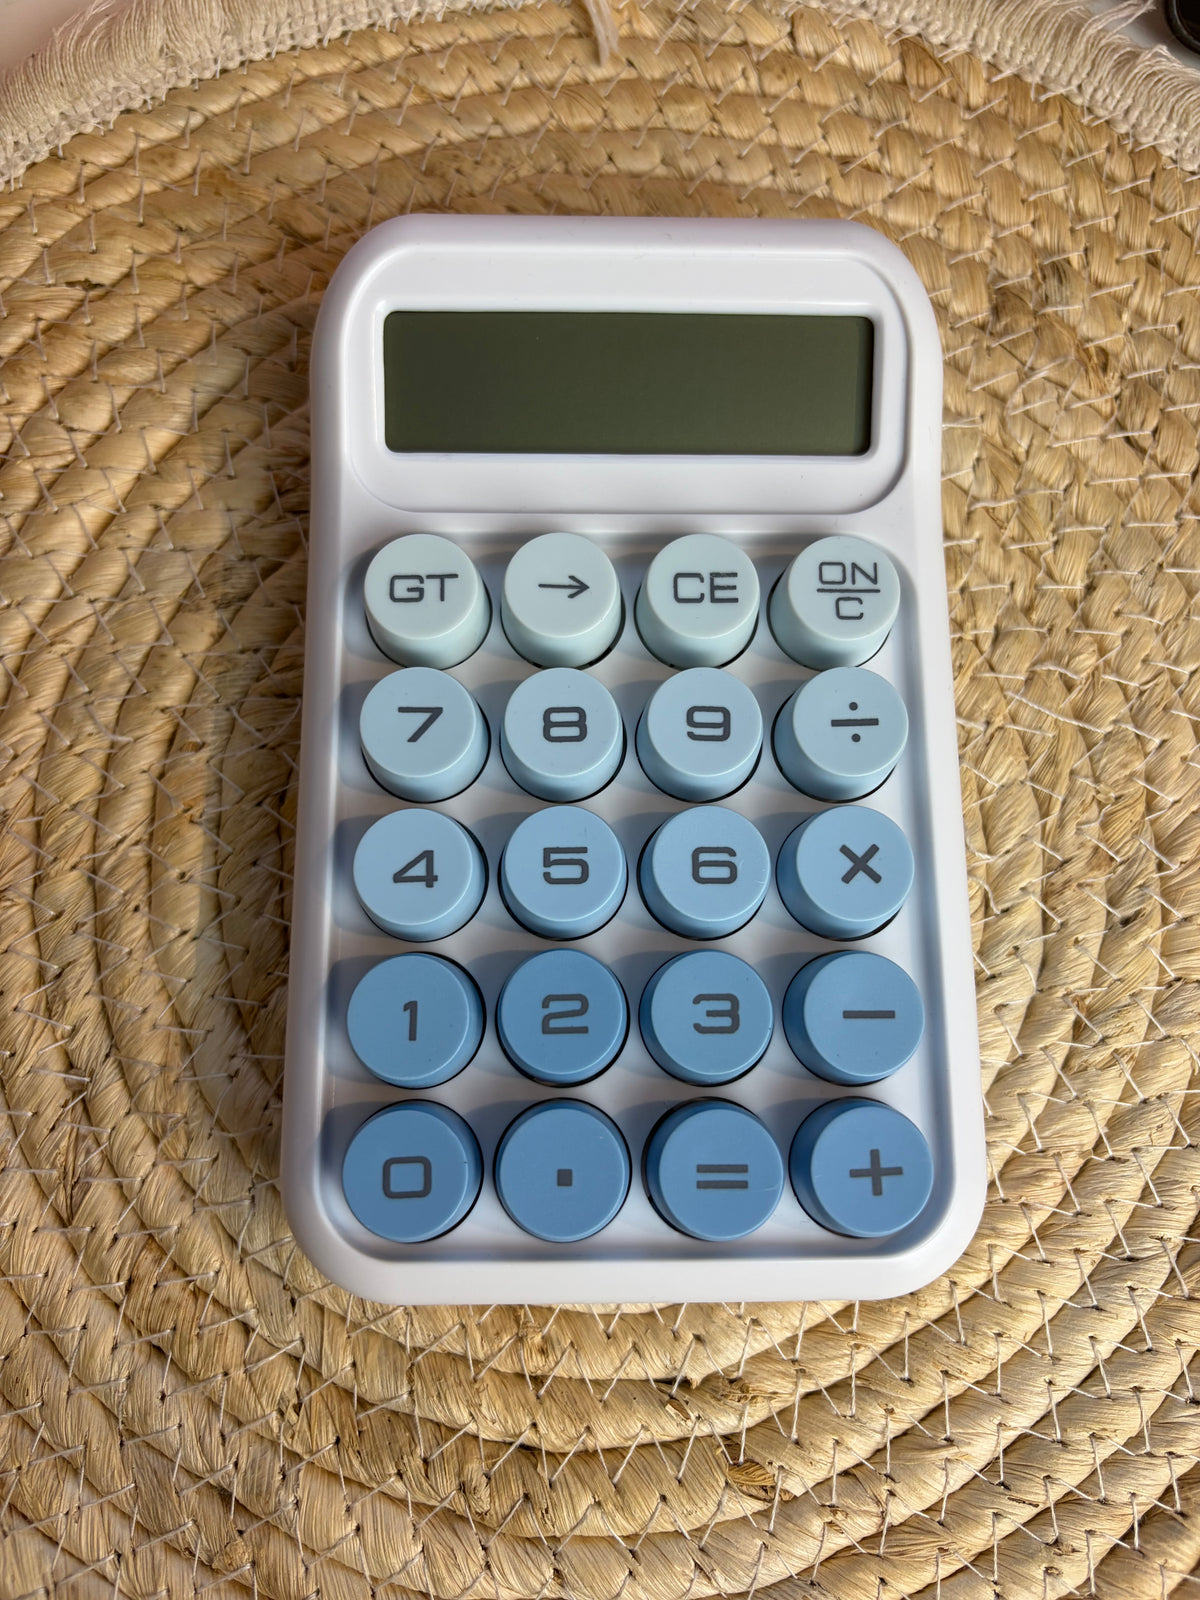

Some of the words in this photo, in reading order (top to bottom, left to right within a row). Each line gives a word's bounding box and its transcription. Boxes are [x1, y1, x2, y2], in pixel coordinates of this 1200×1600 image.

[388, 573, 459, 604] GT
[672, 571, 740, 604] CE
[818, 561, 879, 586] ON
[834, 595, 865, 621] C
[397, 706, 444, 743] 7
[542, 706, 588, 744] 8
[685, 705, 732, 743] 9
[392, 849, 439, 889] 4
[542, 846, 590, 885] 5
[691, 846, 738, 885] 6
[402, 1000, 418, 1042] 1
[541, 993, 590, 1035] 2
[692, 992, 741, 1035] 3
[381, 1155, 433, 1200] 0
